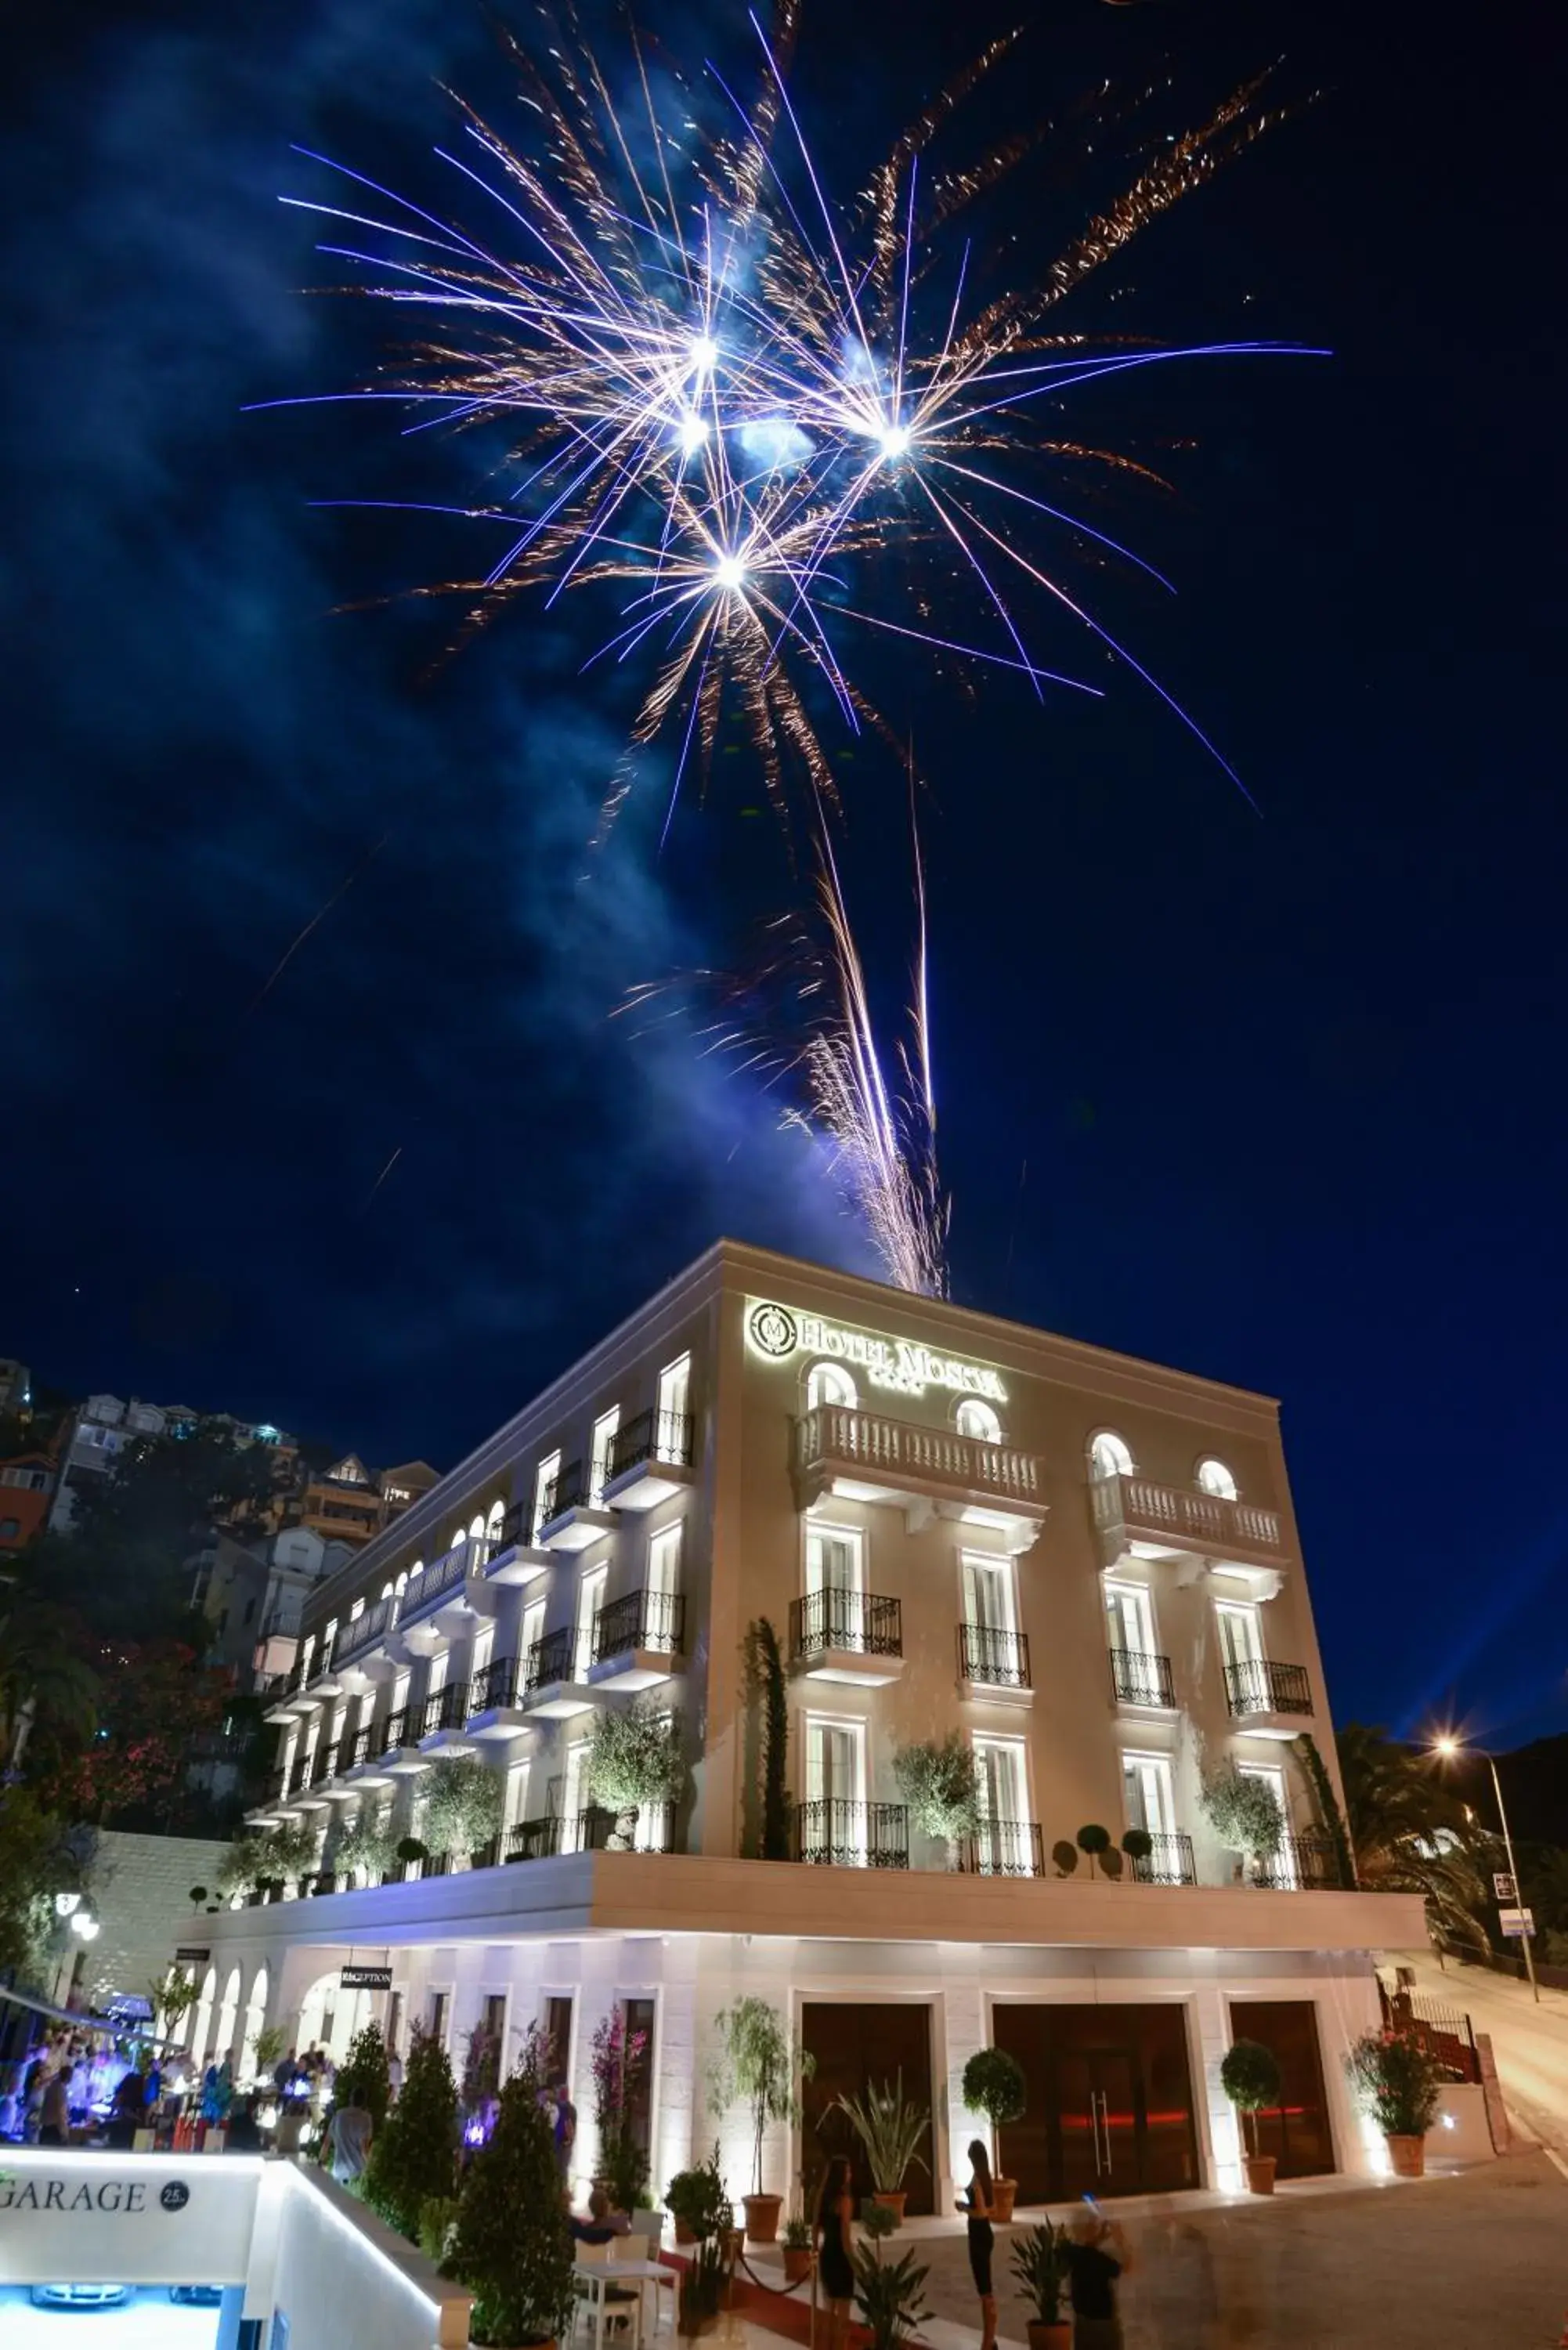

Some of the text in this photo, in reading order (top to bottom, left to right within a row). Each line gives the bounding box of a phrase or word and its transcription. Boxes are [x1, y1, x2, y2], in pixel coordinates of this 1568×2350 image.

[801, 1318, 893, 1367] HOTEL
[342, 1972, 390, 1983] RECEPTION
[0, 2180, 146, 2212] GARAGE
